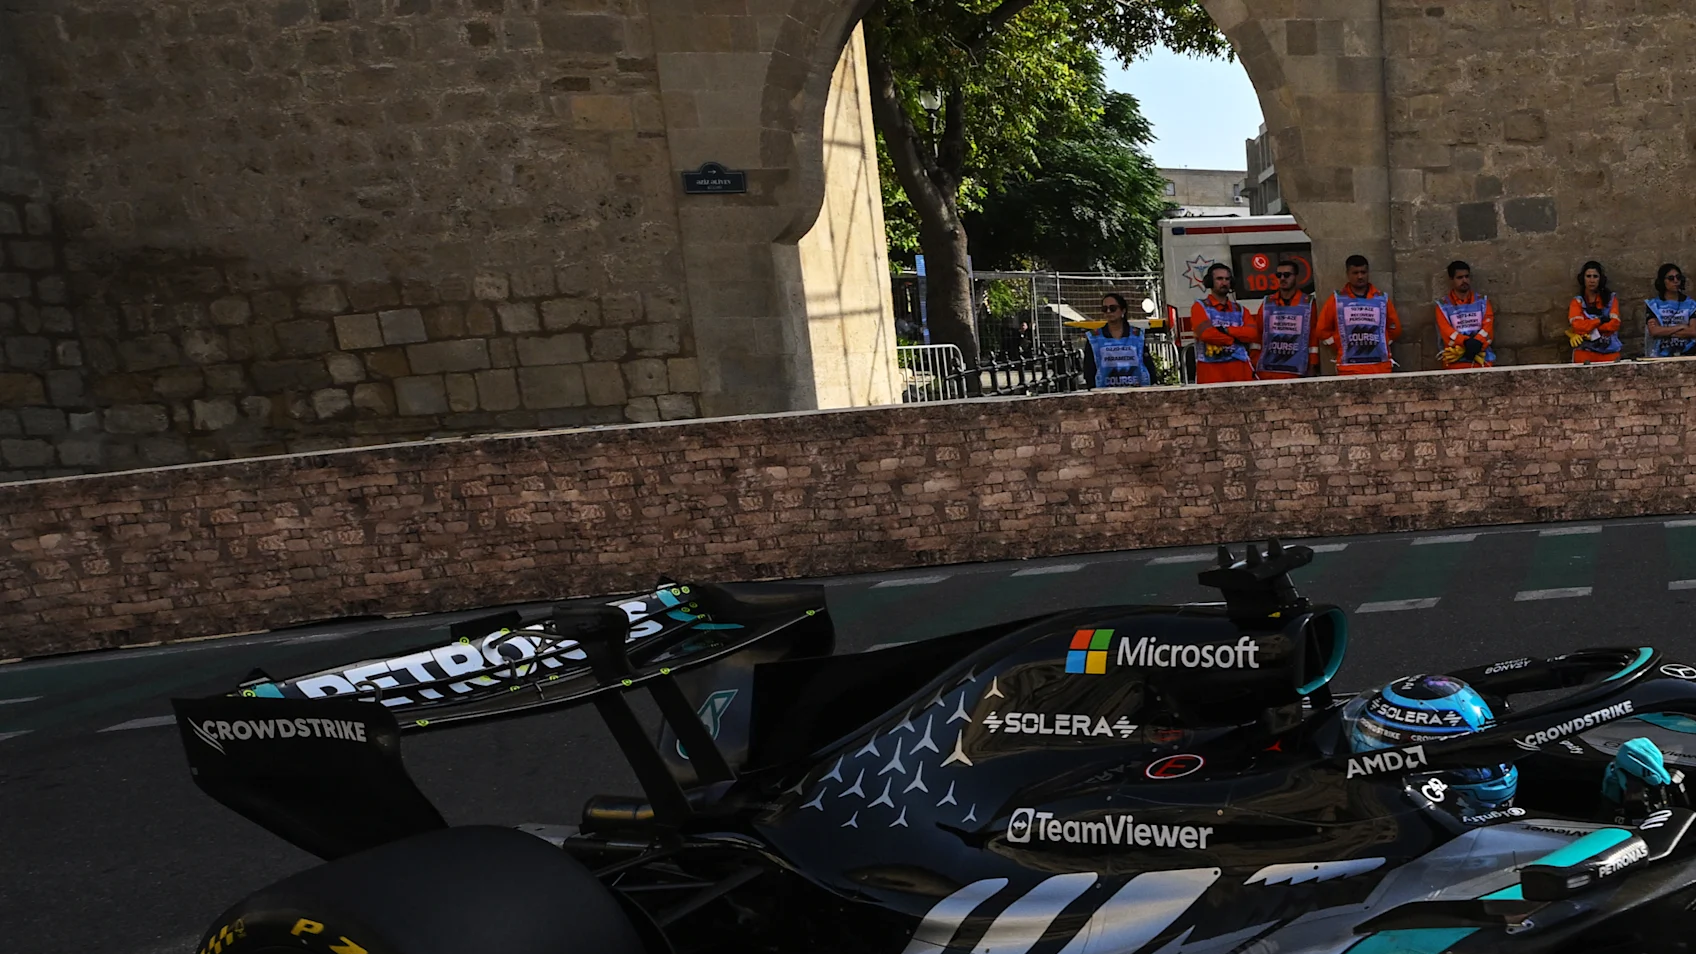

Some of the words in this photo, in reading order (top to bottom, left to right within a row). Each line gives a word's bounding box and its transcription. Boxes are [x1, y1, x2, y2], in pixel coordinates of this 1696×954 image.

[1246, 274, 1280, 291] 103
[1117, 635, 1259, 670] Microsoft
[1003, 712, 1115, 738] SOLERA
[1376, 703, 1443, 725] SOLERA
[1525, 700, 1634, 746] CROWDSTRIKE
[203, 717, 368, 744] CROWDSTRIKE
[1346, 751, 1404, 779] AMD
[1036, 815, 1214, 850] TeamViewer
[1599, 846, 1649, 879] PETRONAS
[290, 917, 325, 937] P
